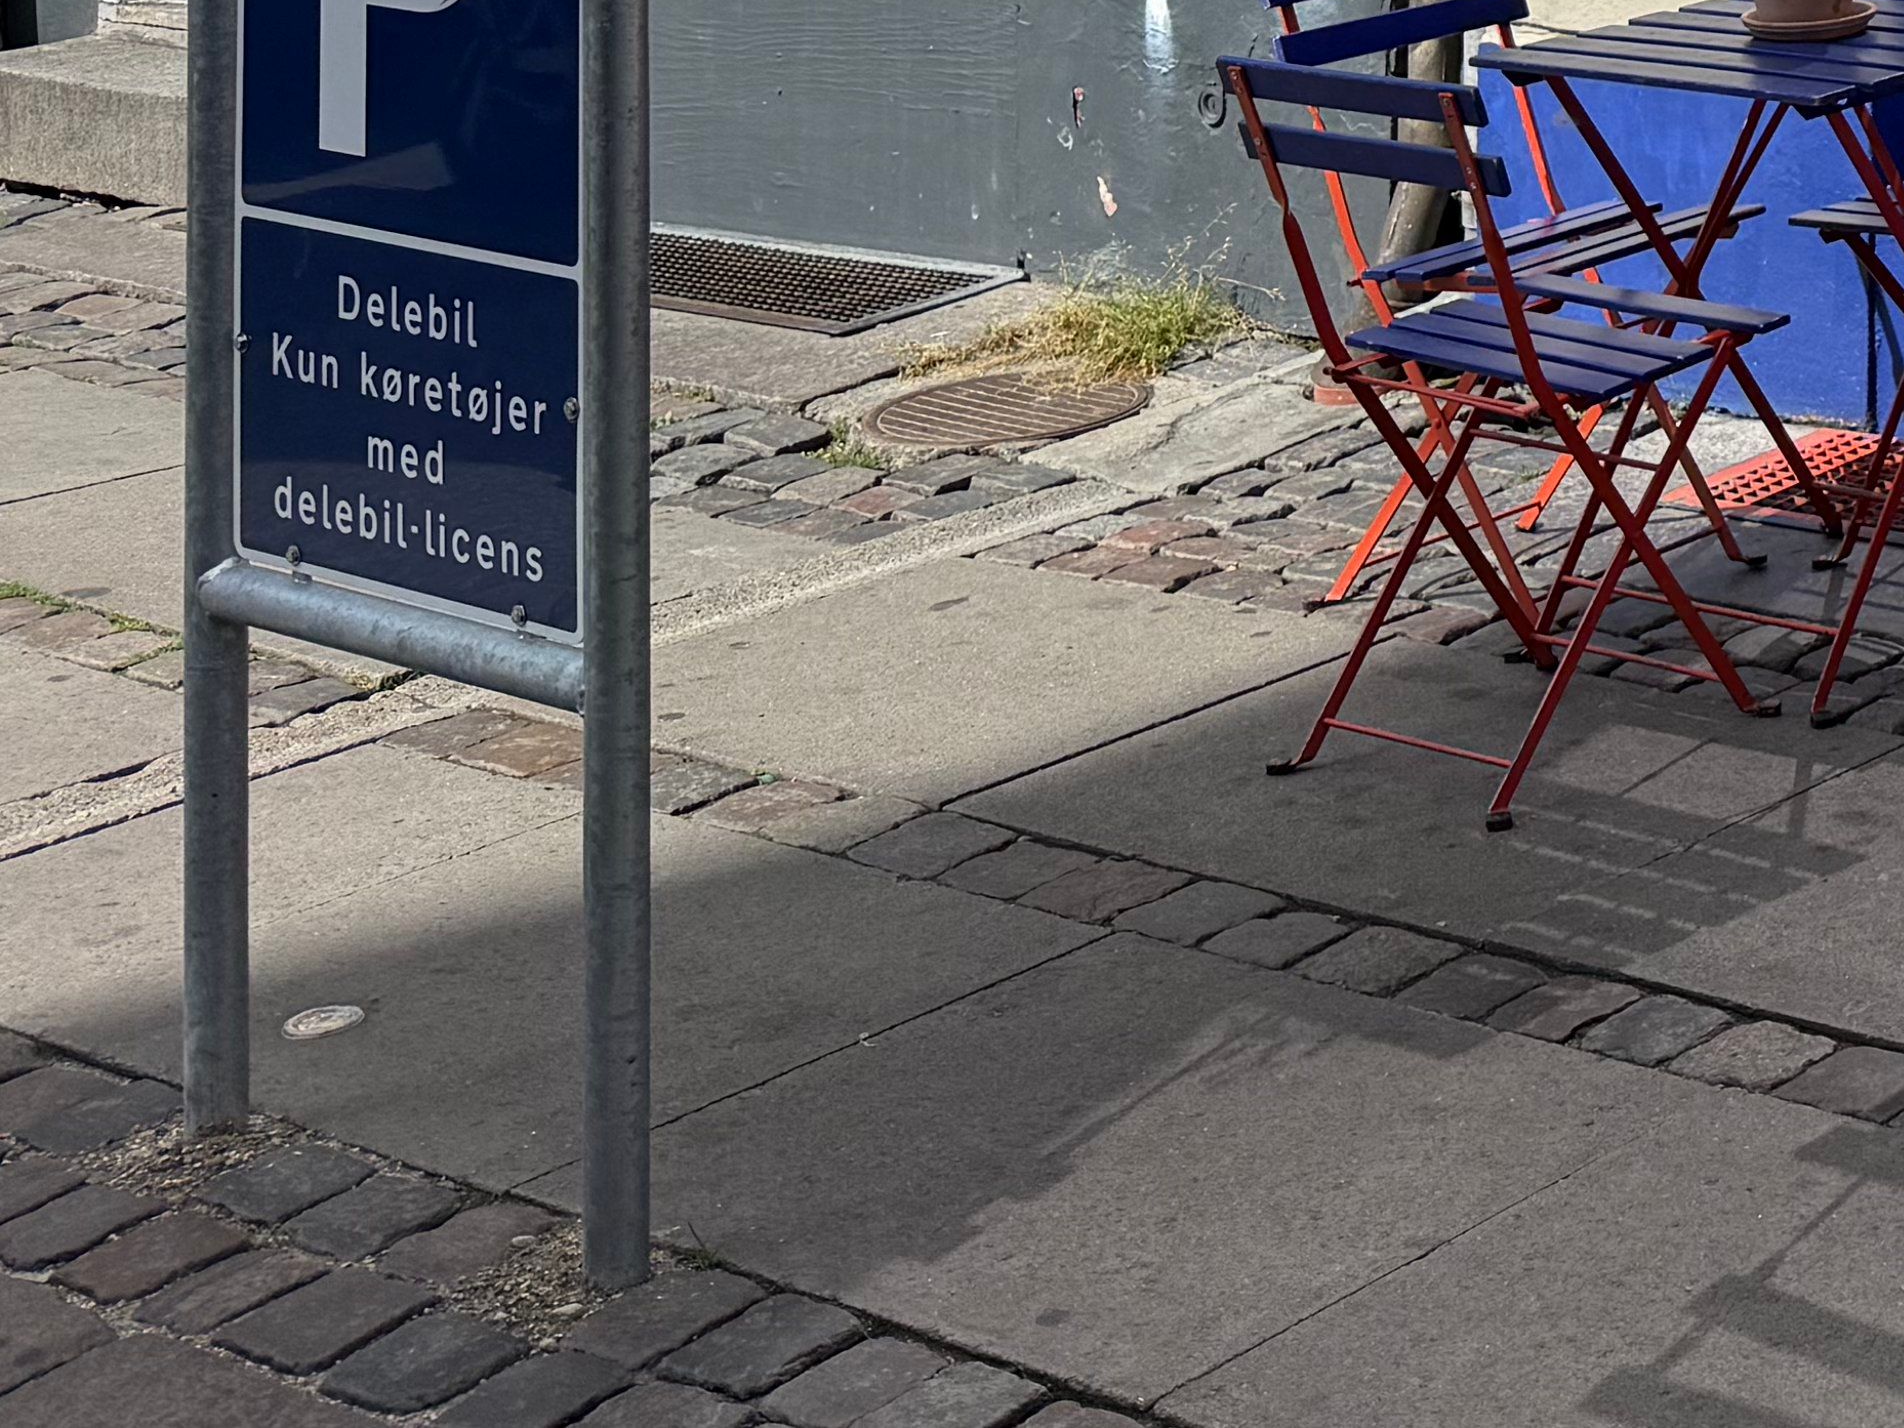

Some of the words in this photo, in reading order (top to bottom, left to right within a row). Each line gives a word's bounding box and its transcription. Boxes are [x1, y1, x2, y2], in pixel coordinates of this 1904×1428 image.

[336, 273, 478, 349] Delebil
[270, 332, 340, 390] Kun
[358, 358, 548, 438] køretøjer
[365, 428, 446, 486] med
[272, 475, 545, 584] delebil-licens
